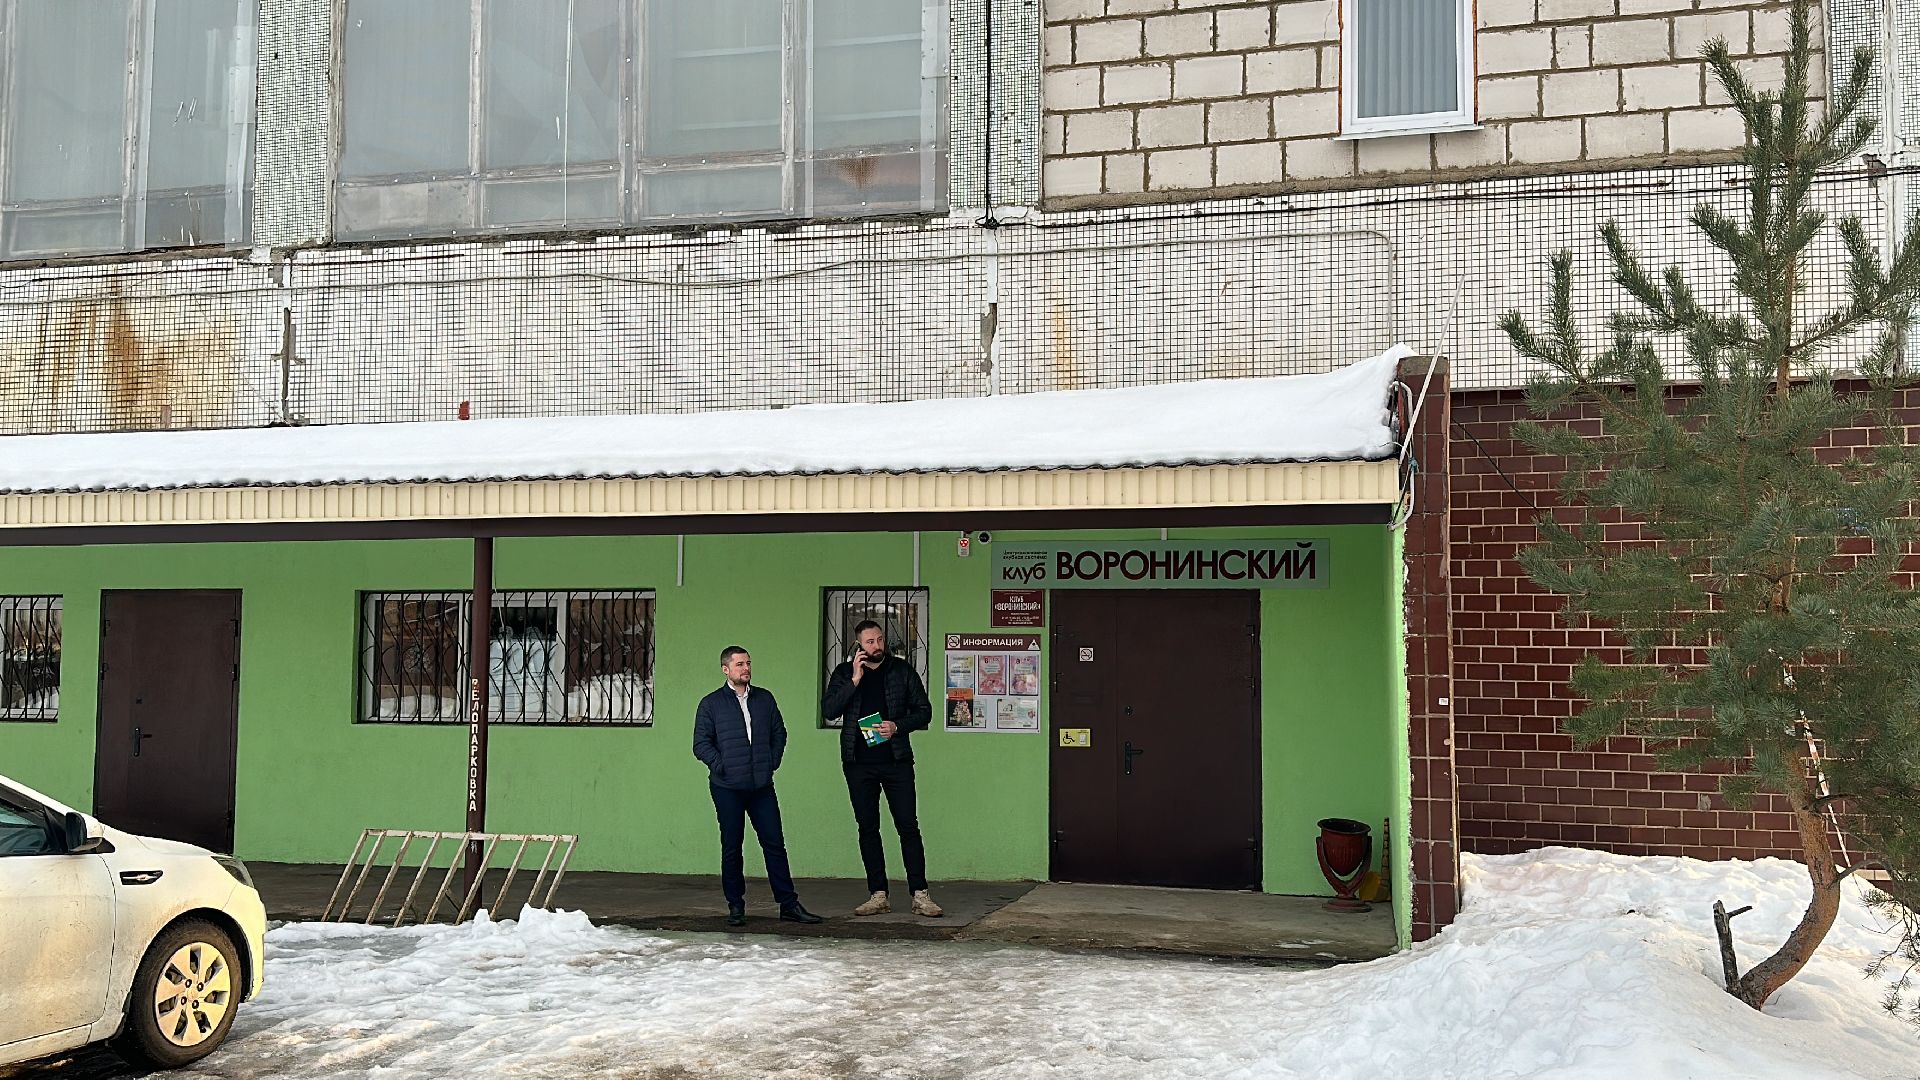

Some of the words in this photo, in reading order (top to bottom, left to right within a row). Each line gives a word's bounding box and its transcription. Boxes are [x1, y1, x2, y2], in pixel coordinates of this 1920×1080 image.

[1003, 562, 1046, 584] клуб
[1056, 541, 1316, 580] ВОРОНИНСКИЙ
[963, 638, 1024, 647] ИНФОРМАЦИЯ
